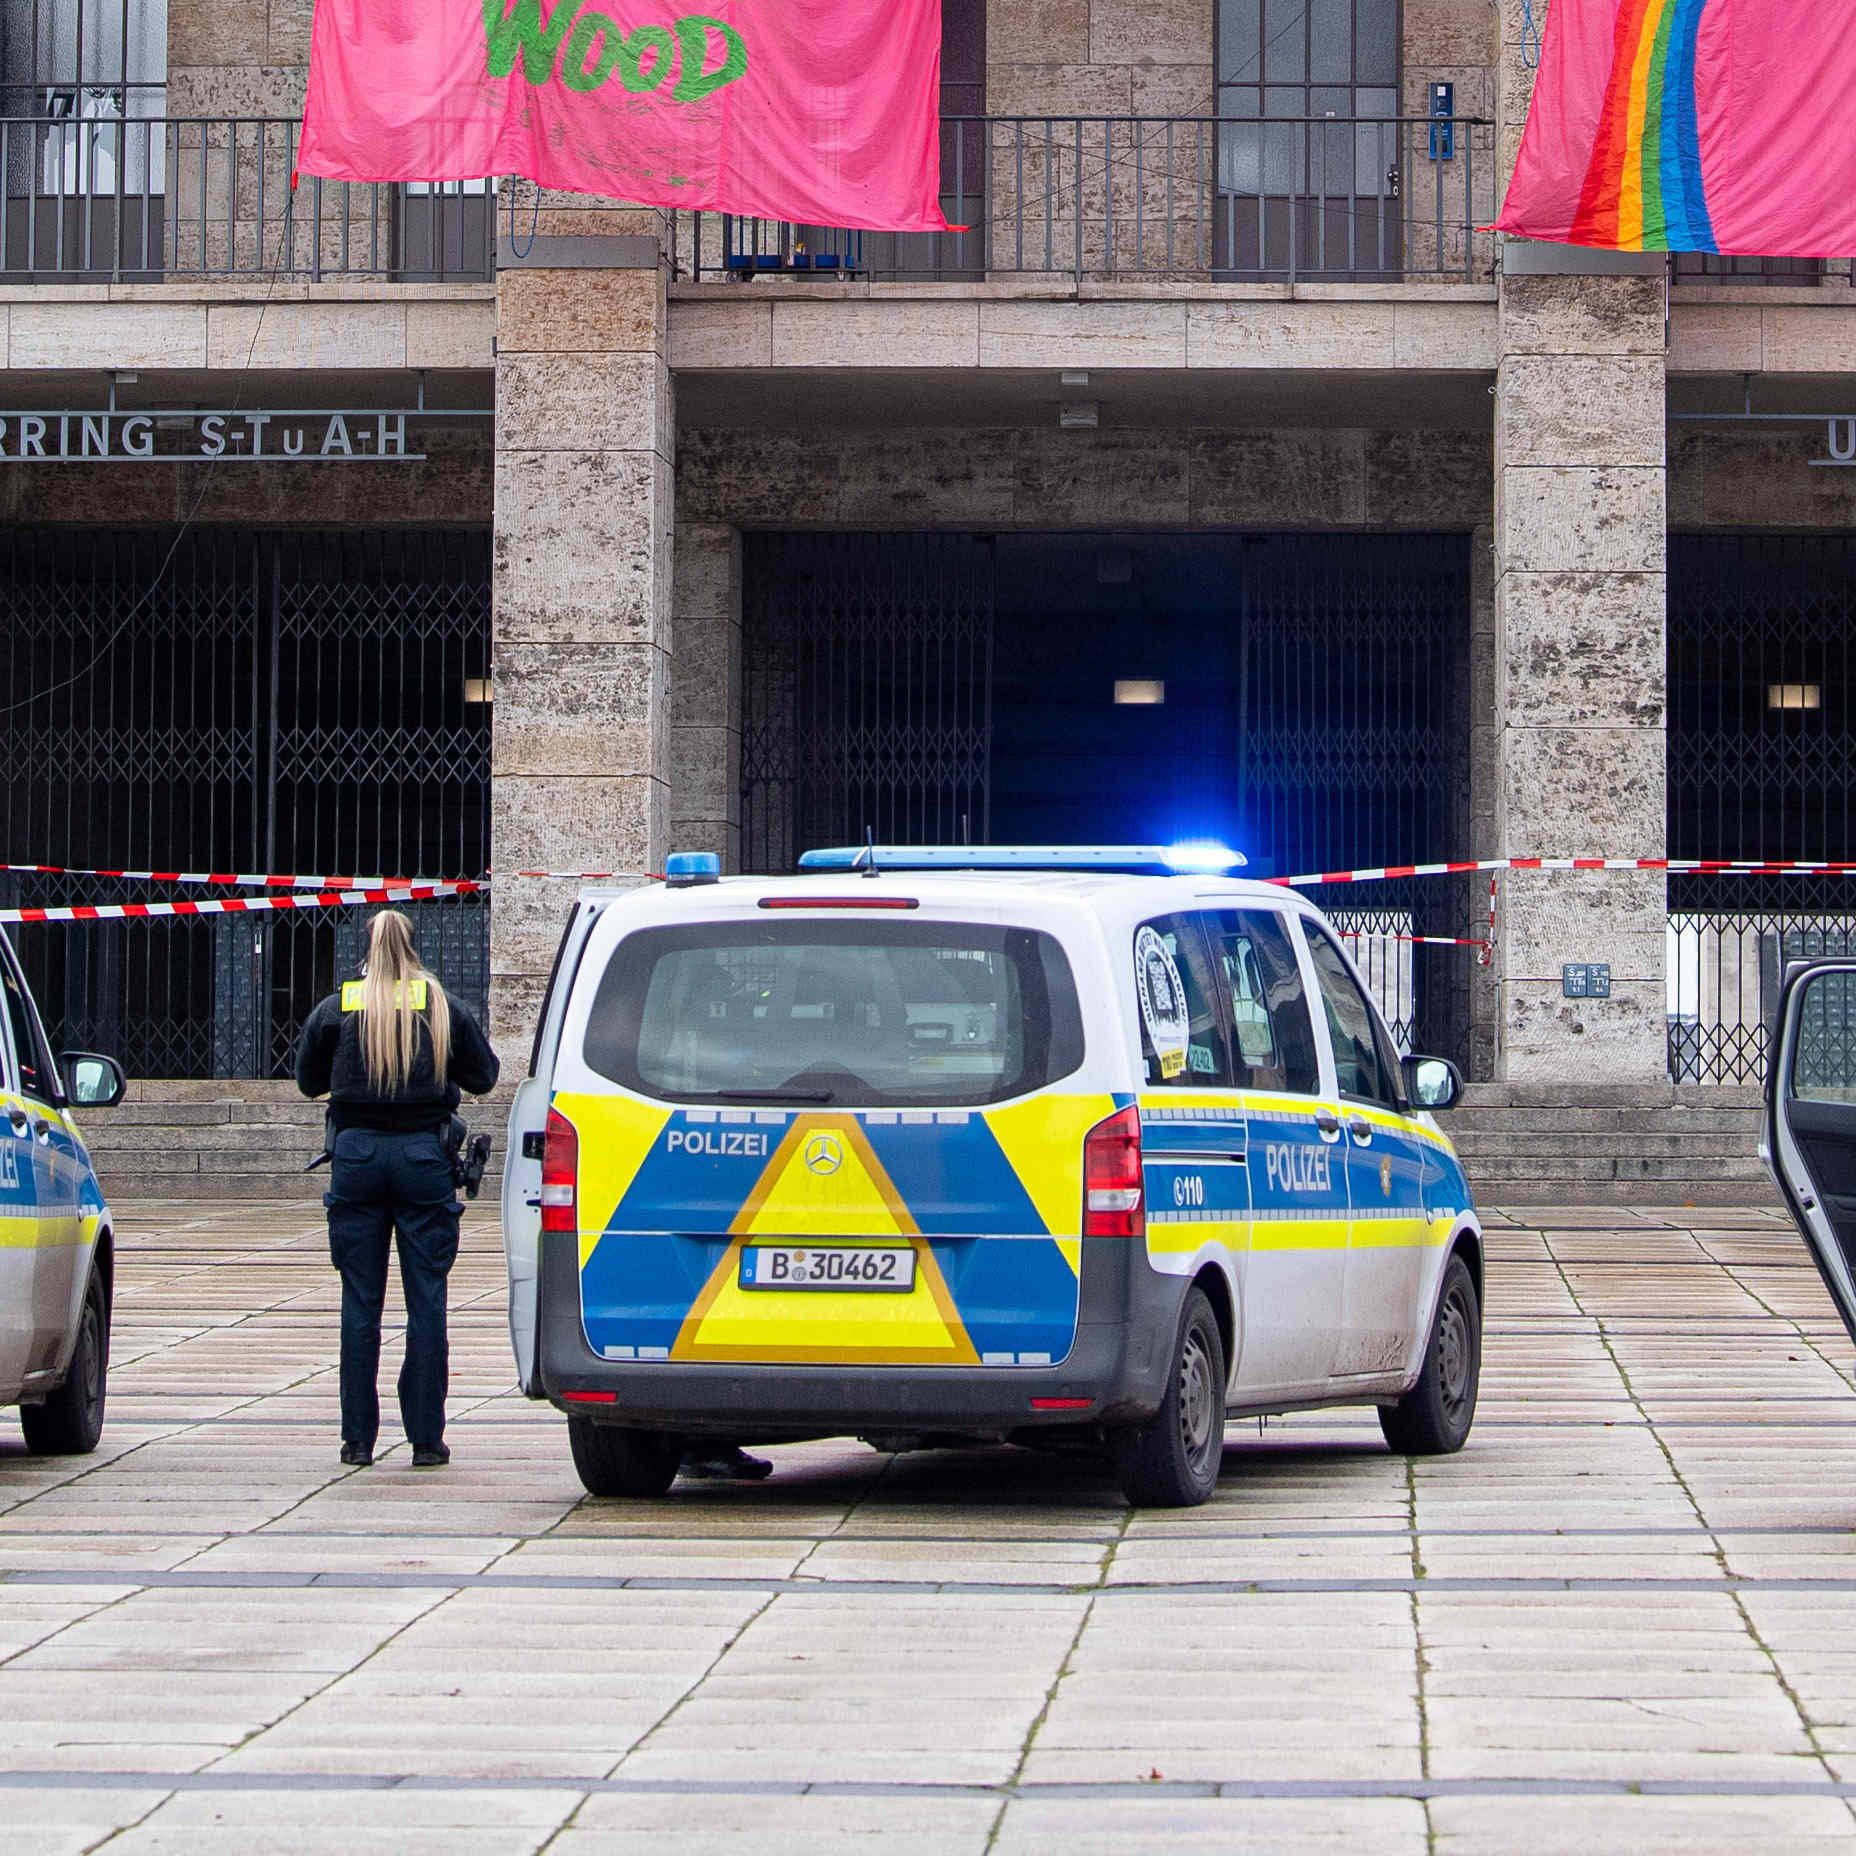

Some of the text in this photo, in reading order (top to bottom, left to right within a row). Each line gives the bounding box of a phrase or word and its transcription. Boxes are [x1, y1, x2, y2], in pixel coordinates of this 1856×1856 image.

[320, 415, 405, 456] A-H
[667, 1131, 768, 1156] POLIZEI
[1266, 1144, 1332, 1193] POLIZEI
[1184, 1175, 1203, 1206] 110
[772, 1252, 789, 1279] B
[809, 1252, 896, 1281] 30462
